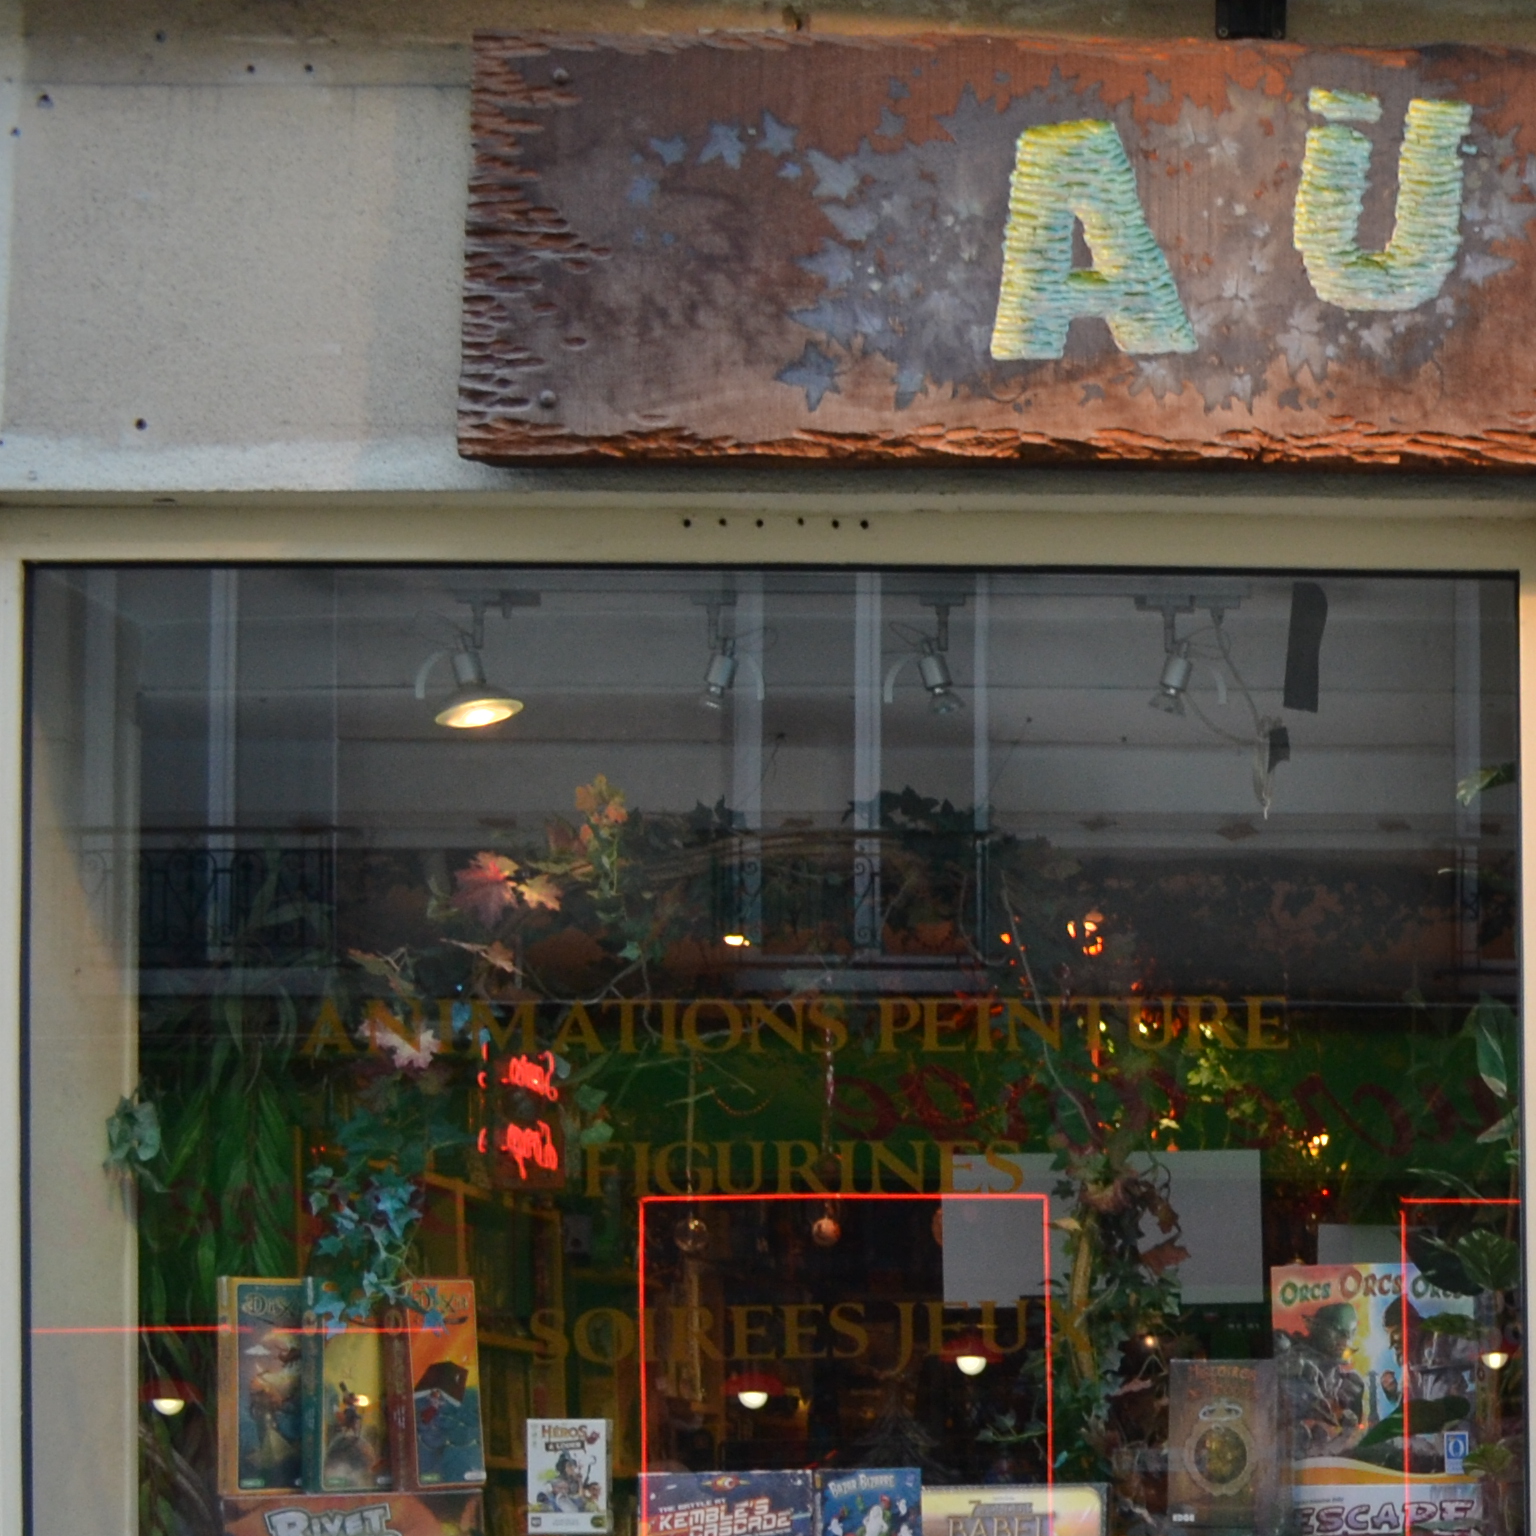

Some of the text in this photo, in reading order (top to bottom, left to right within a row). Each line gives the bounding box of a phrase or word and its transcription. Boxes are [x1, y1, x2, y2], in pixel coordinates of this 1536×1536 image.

[990, 88, 1474, 360] AU
[303, 995, 1289, 1055] ANIMATIONS PEINTURE
[584, 1139, 1023, 1196] FIGURINES
[1280, 1268, 1403, 1307] ORCS ORCS
[894, 1300, 1091, 1361] JEUX
[658, 1498, 771, 1532] KEMBLE'S
[1296, 1500, 1475, 1534] ESCAPE
